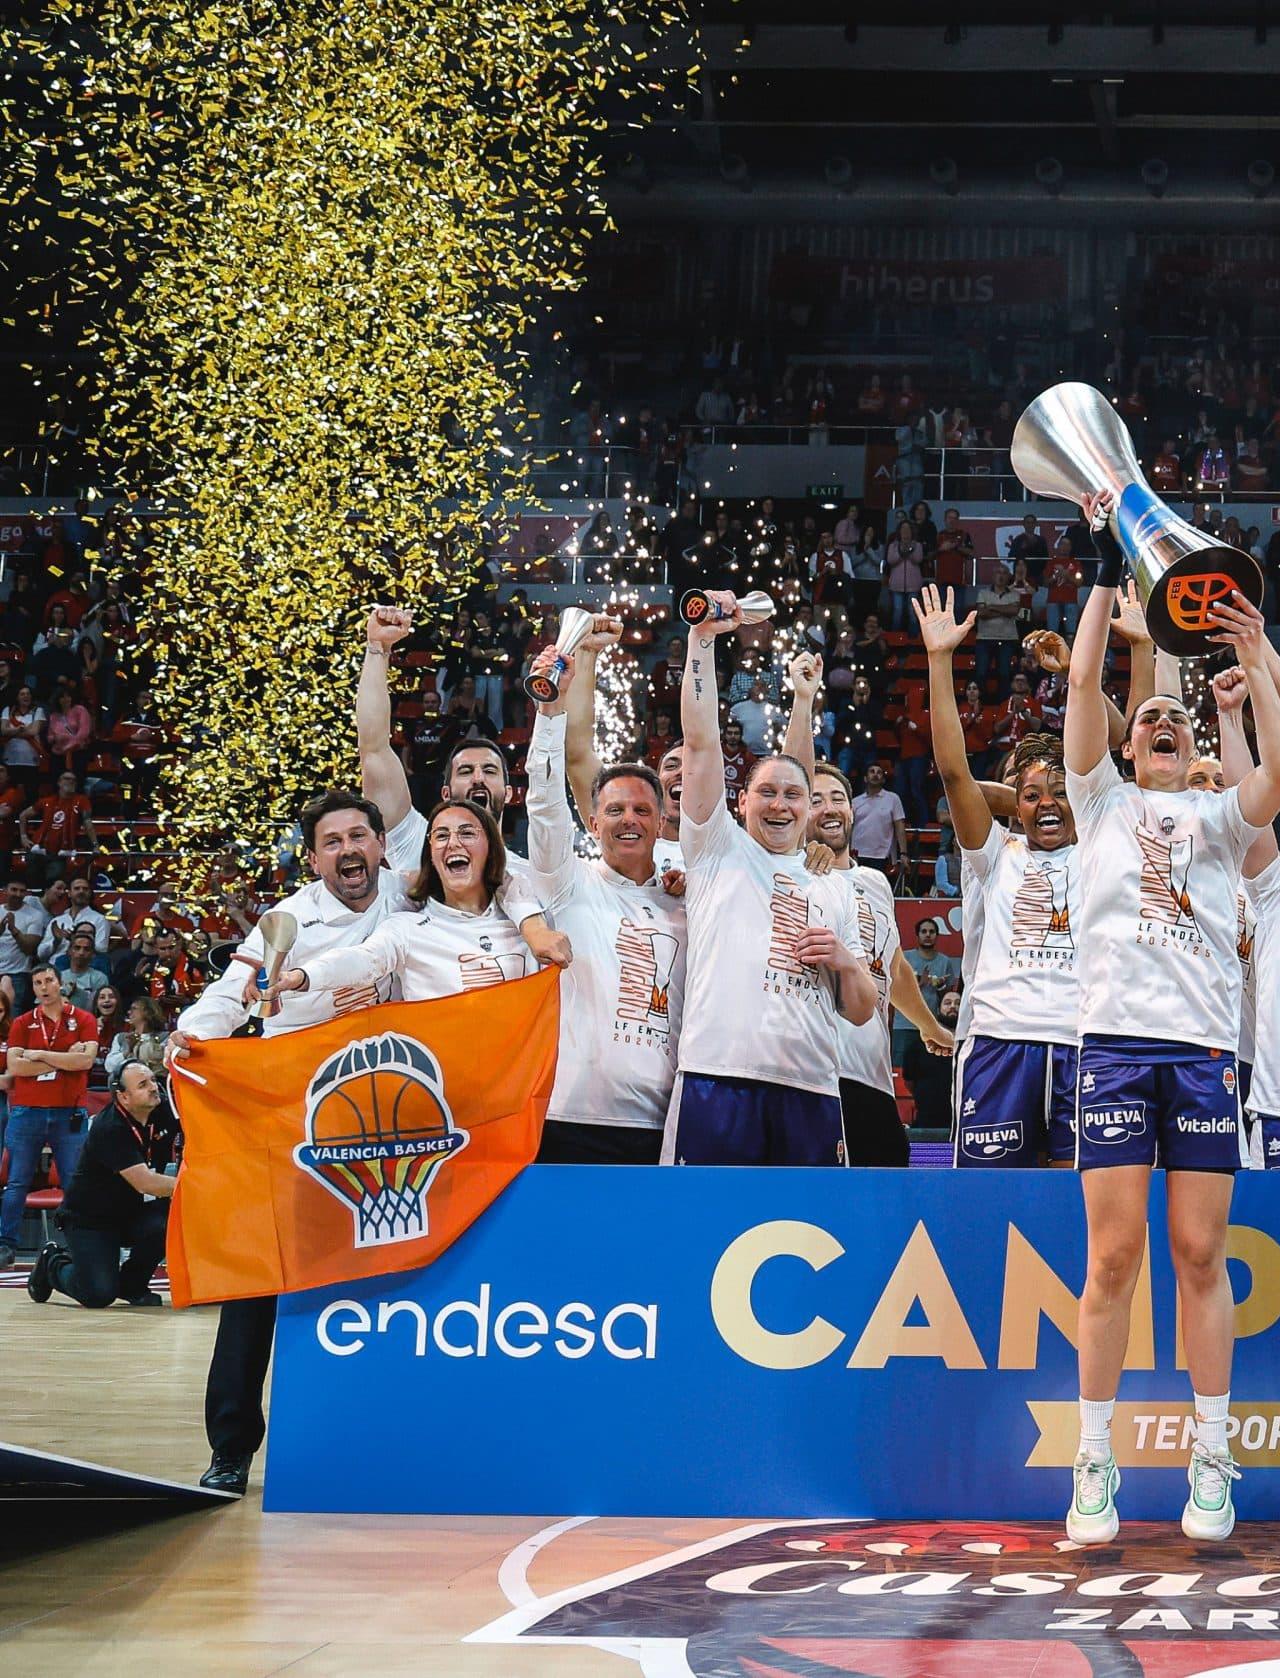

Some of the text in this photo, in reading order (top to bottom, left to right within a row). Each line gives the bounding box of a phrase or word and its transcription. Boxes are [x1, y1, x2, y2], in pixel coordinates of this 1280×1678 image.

[840, 265, 994, 304] hiberus
[811, 487, 838, 496] EXIT
[1138, 922, 1204, 944] LF ENDES
[1009, 950, 1020, 959] LF
[765, 970, 778, 981] LF
[614, 1020, 629, 1031] LF
[1085, 1109, 1143, 1127] PULEVA
[1177, 1116, 1236, 1134] Vitaldin
[965, 1128, 1019, 1146] PULEVA
[310, 1138, 455, 1161] VALENCIA BASKET
[316, 1283, 659, 1359] endesa
